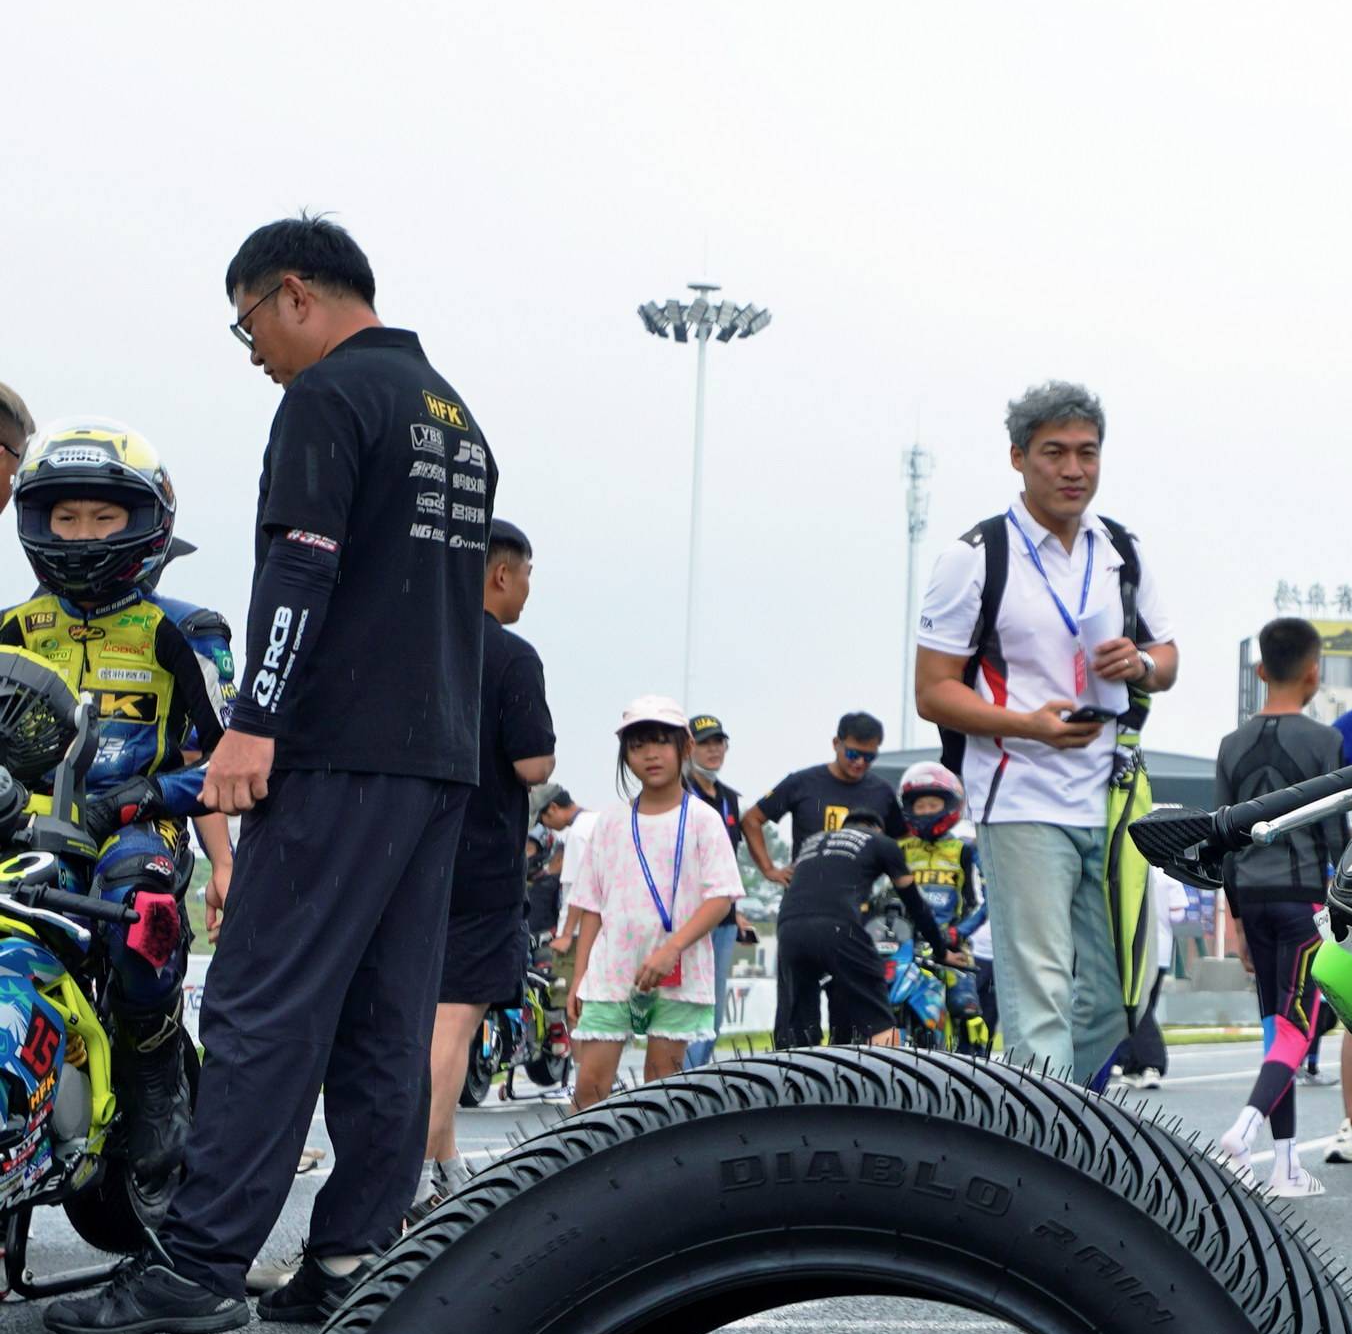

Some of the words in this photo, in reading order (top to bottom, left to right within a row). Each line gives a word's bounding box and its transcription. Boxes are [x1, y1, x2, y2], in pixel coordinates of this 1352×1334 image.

[427, 396, 462, 425] HFK
[421, 426, 443, 445] YBS
[30, 612, 54, 625] YBS
[263, 606, 293, 668] RCB
[21, 1015, 60, 1078] 15
[30, 1070, 56, 1110] HFK
[719, 1150, 1014, 1217] DIABLO
